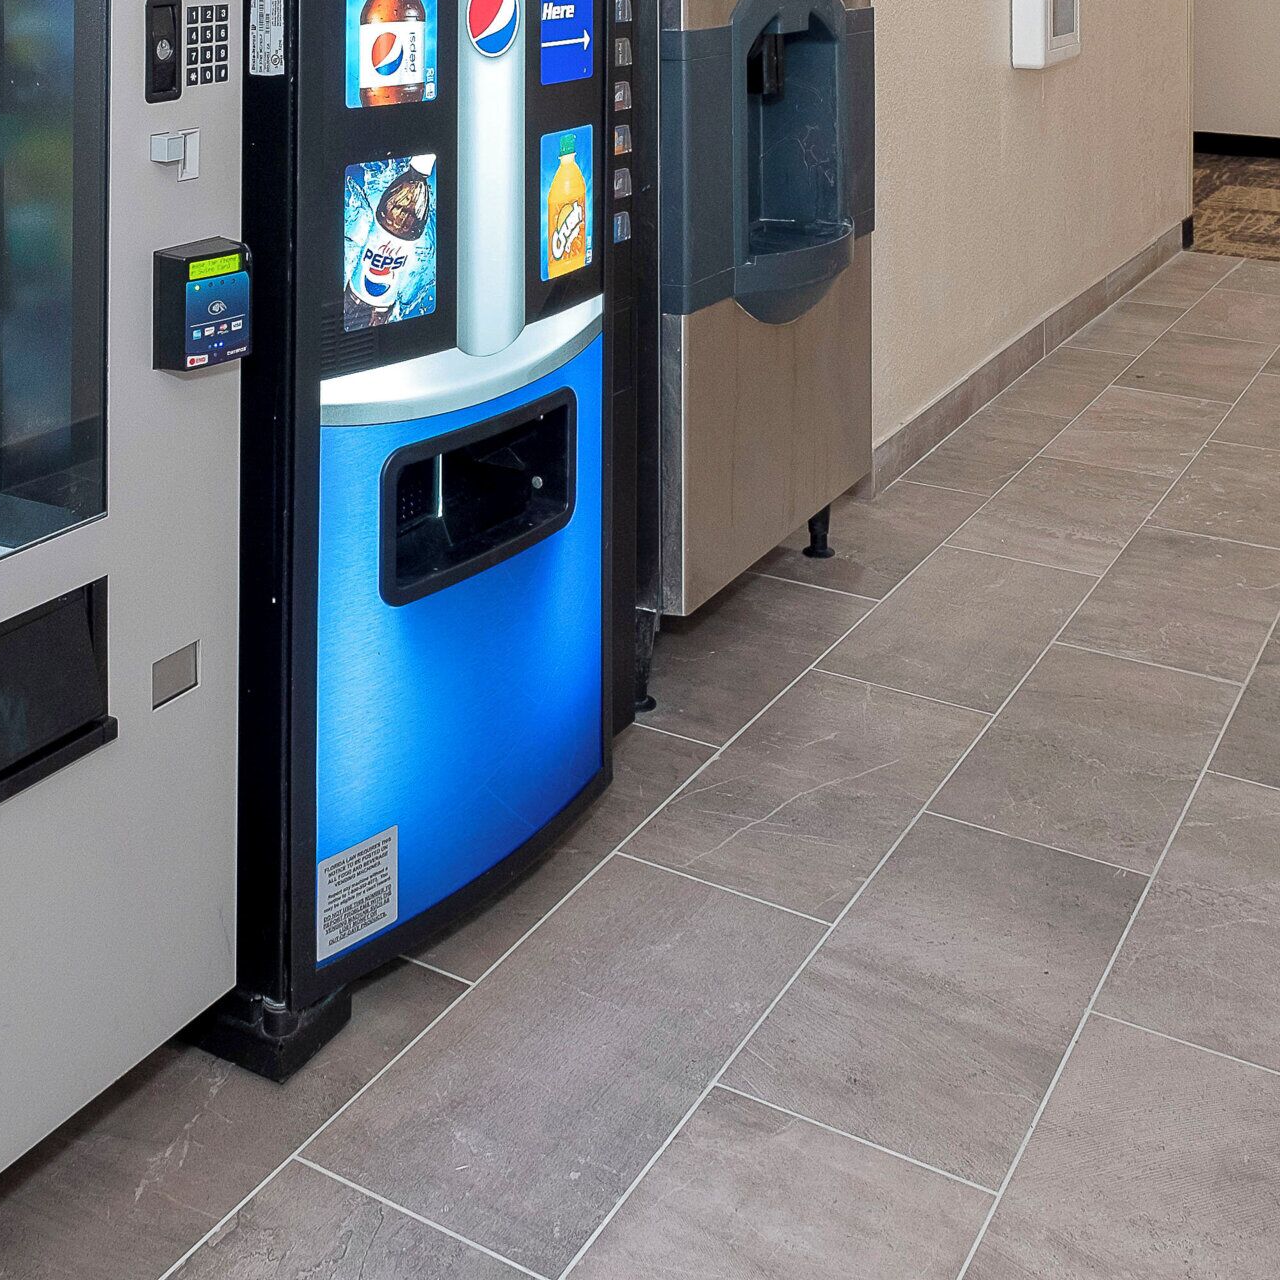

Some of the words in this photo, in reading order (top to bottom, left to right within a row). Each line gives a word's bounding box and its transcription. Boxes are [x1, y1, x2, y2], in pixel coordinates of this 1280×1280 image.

[192, 11, 196, 19] 1
[542, 2, 575, 20] Here
[192, 32, 196, 40] 4
[206, 51, 210, 59] 8
[206, 71, 210, 79] 0
[363, 248, 408, 270] PEPSI
